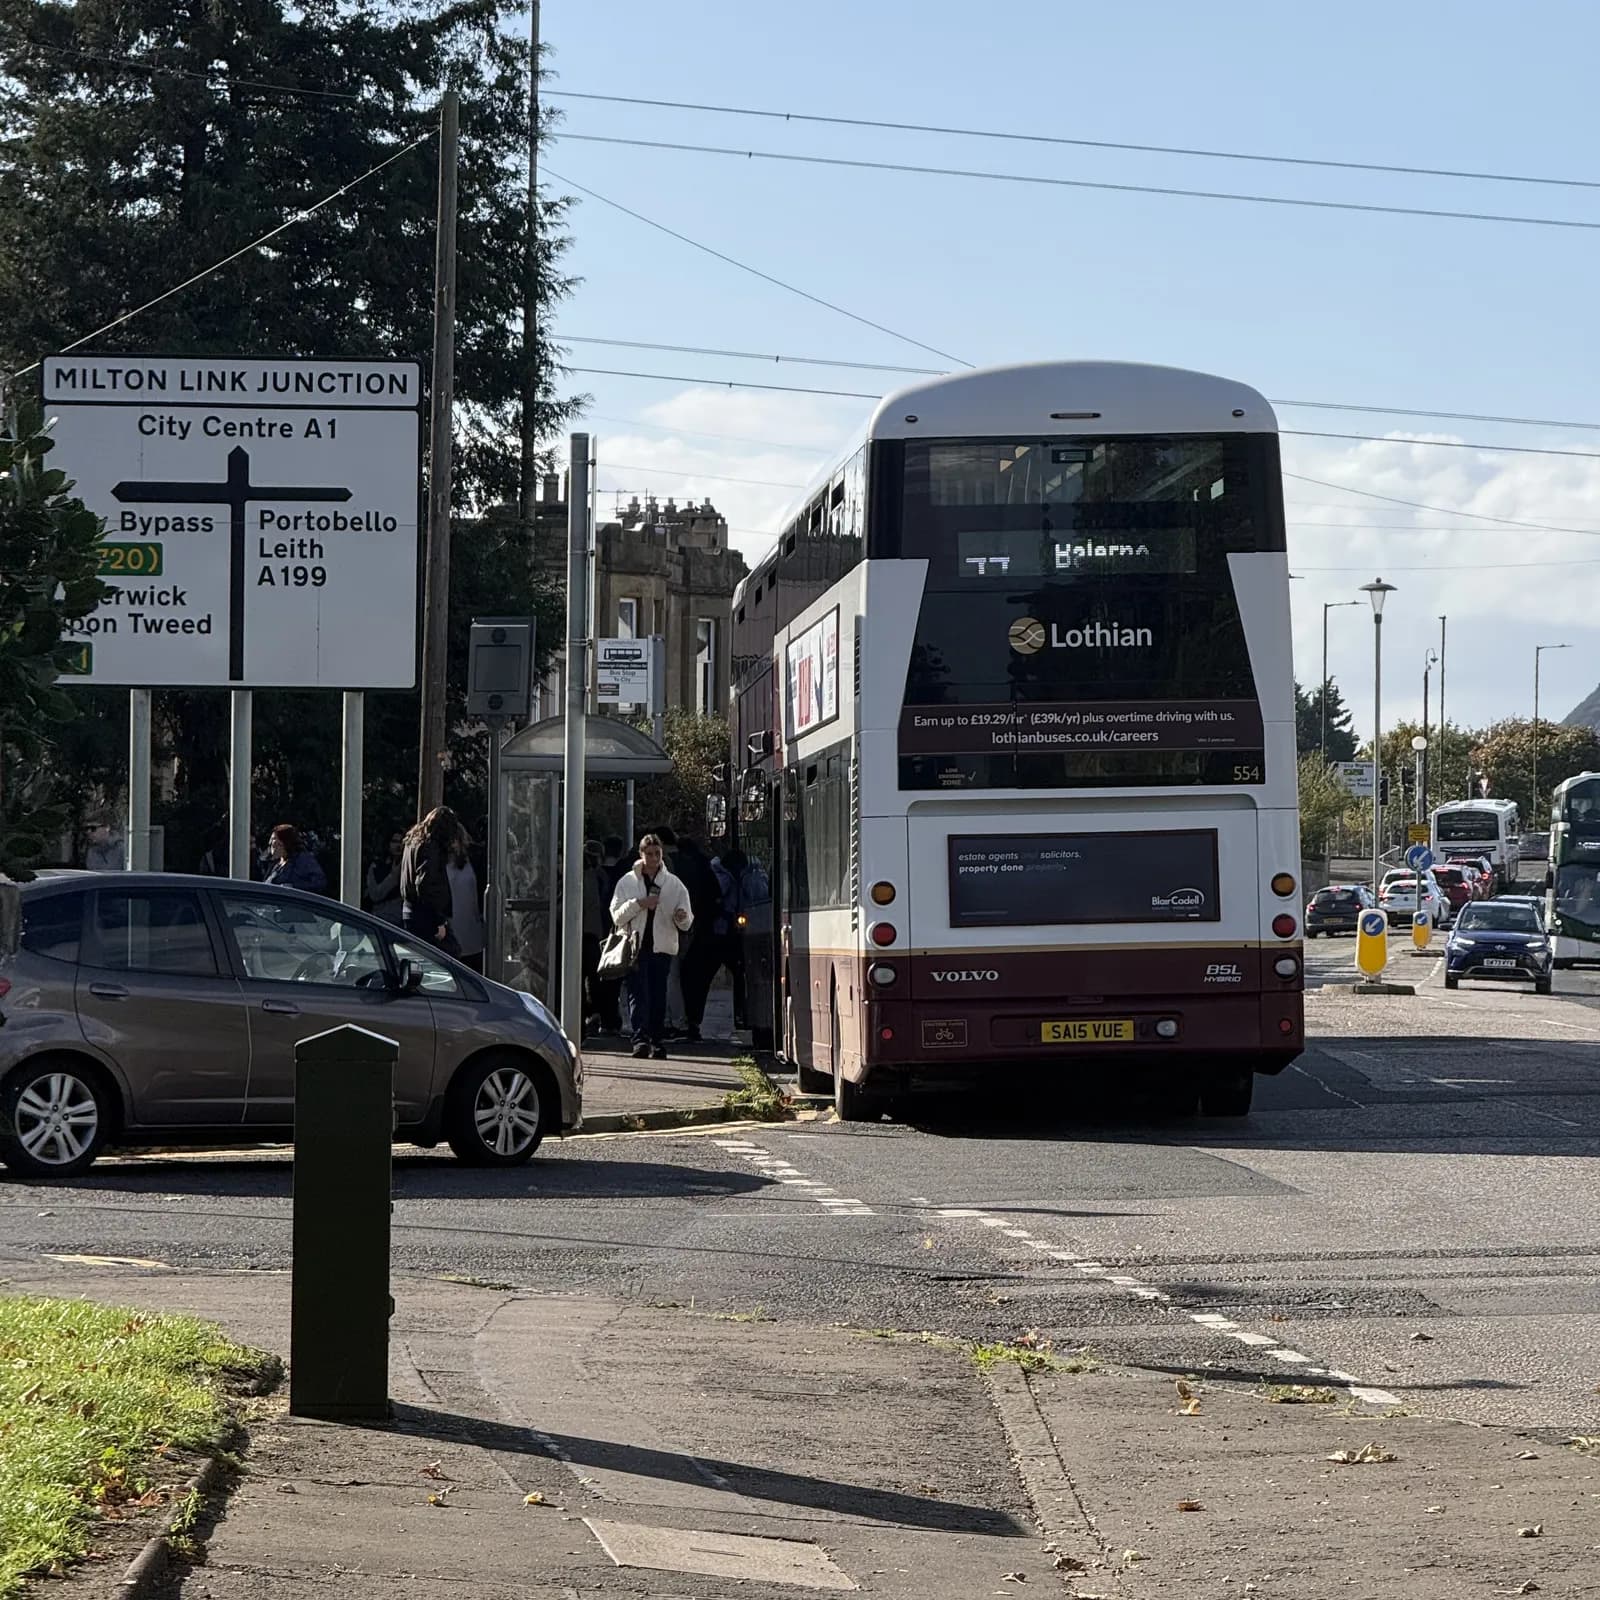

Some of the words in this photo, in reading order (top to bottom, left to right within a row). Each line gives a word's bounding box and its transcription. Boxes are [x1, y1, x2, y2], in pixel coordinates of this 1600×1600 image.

[55, 368, 167, 390] MILTON
[180, 369, 247, 392] LINK
[257, 371, 408, 394] JUNCTION
[137, 414, 192, 440] City
[202, 415, 293, 438] Centre
[304, 417, 337, 439] A1
[120, 510, 214, 536] Bypass
[259, 509, 398, 532] Portobello
[259, 537, 324, 559] Leith
[97, 546, 160, 573] 720)
[257, 565, 327, 587] A199
[100, 585, 188, 606] erwick
[67, 616, 117, 636] pon
[127, 613, 212, 635] Tweed
[1051, 622, 1153, 648] Lothian
[914, 715, 938, 727] Earn
[940, 716, 955, 728] up
[957, 715, 969, 725] to
[1031, 710, 1081, 725] (£39k/yr)
[1082, 711, 1104, 724] plus
[1106, 711, 1153, 723] overtime
[1155, 710, 1192, 724] driving
[1194, 709, 1218, 721] with
[1220, 712, 1235, 721] us.
[991, 729, 1159, 744] lothianbuses.co.uk/careers
[1232, 765, 1260, 781] 554
[958, 852, 986, 861] estate
[988, 851, 1019, 862] agents
[959, 863, 999, 874] property
[1000, 863, 1024, 872] done
[930, 969, 999, 982] VOLVO
[1051, 1023, 1088, 1040] SA15
[1092, 1022, 1124, 1039] VUE
